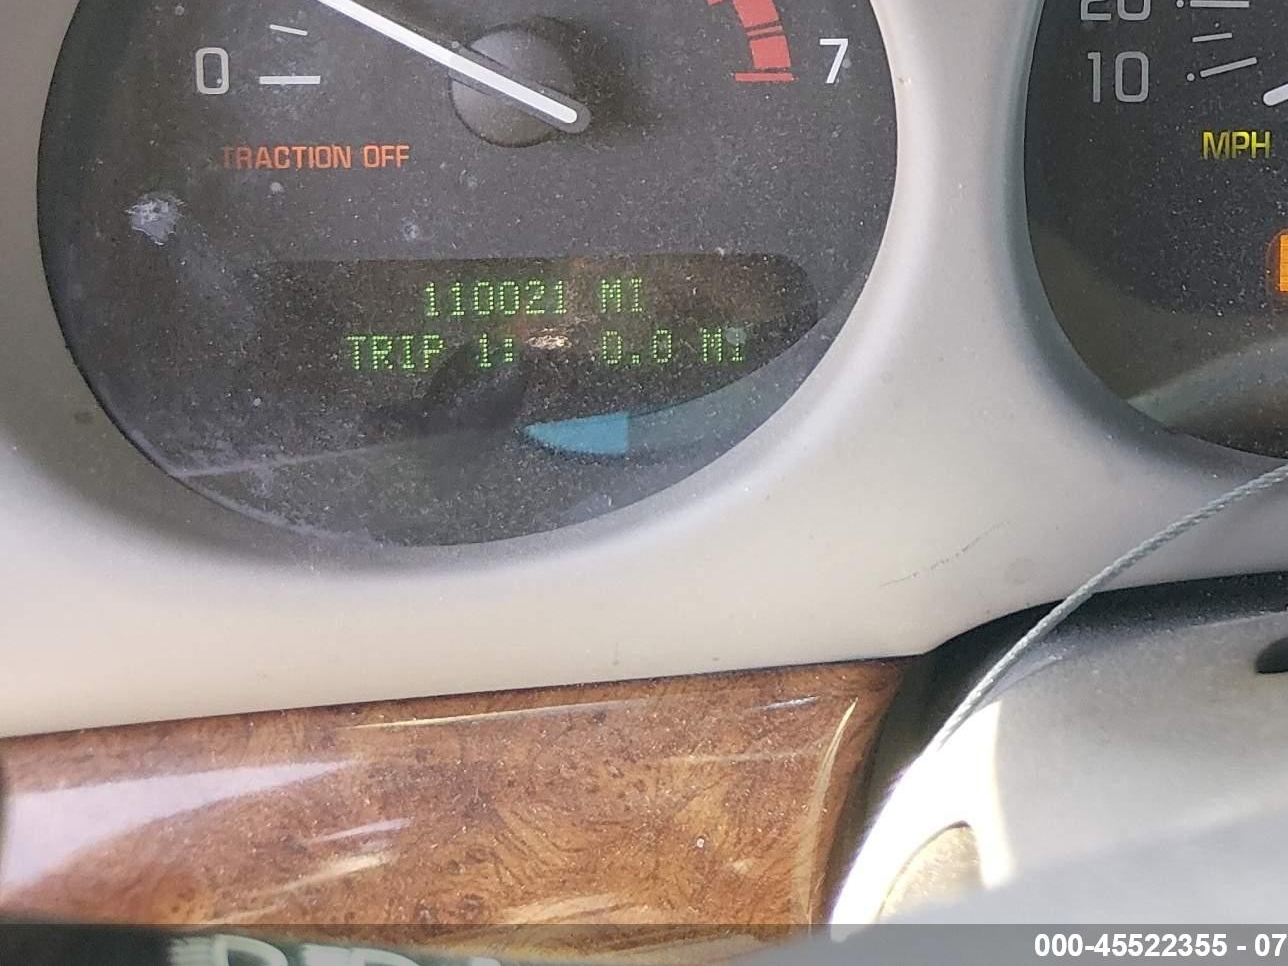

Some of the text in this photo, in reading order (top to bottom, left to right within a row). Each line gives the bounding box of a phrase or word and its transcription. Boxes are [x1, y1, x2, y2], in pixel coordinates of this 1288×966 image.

[194, 47, 229, 96] 0
[819, 38, 851, 85] 7
[1087, 52, 1149, 104] 10
[221, 144, 411, 170] TRACTION OFF
[1202, 131, 1271, 160] MPH
[422, 277, 644, 317] 110021 MI
[345, 333, 445, 370] TRIP
[478, 333, 514, 368] 1:
[600, 329, 674, 365] 0.0
